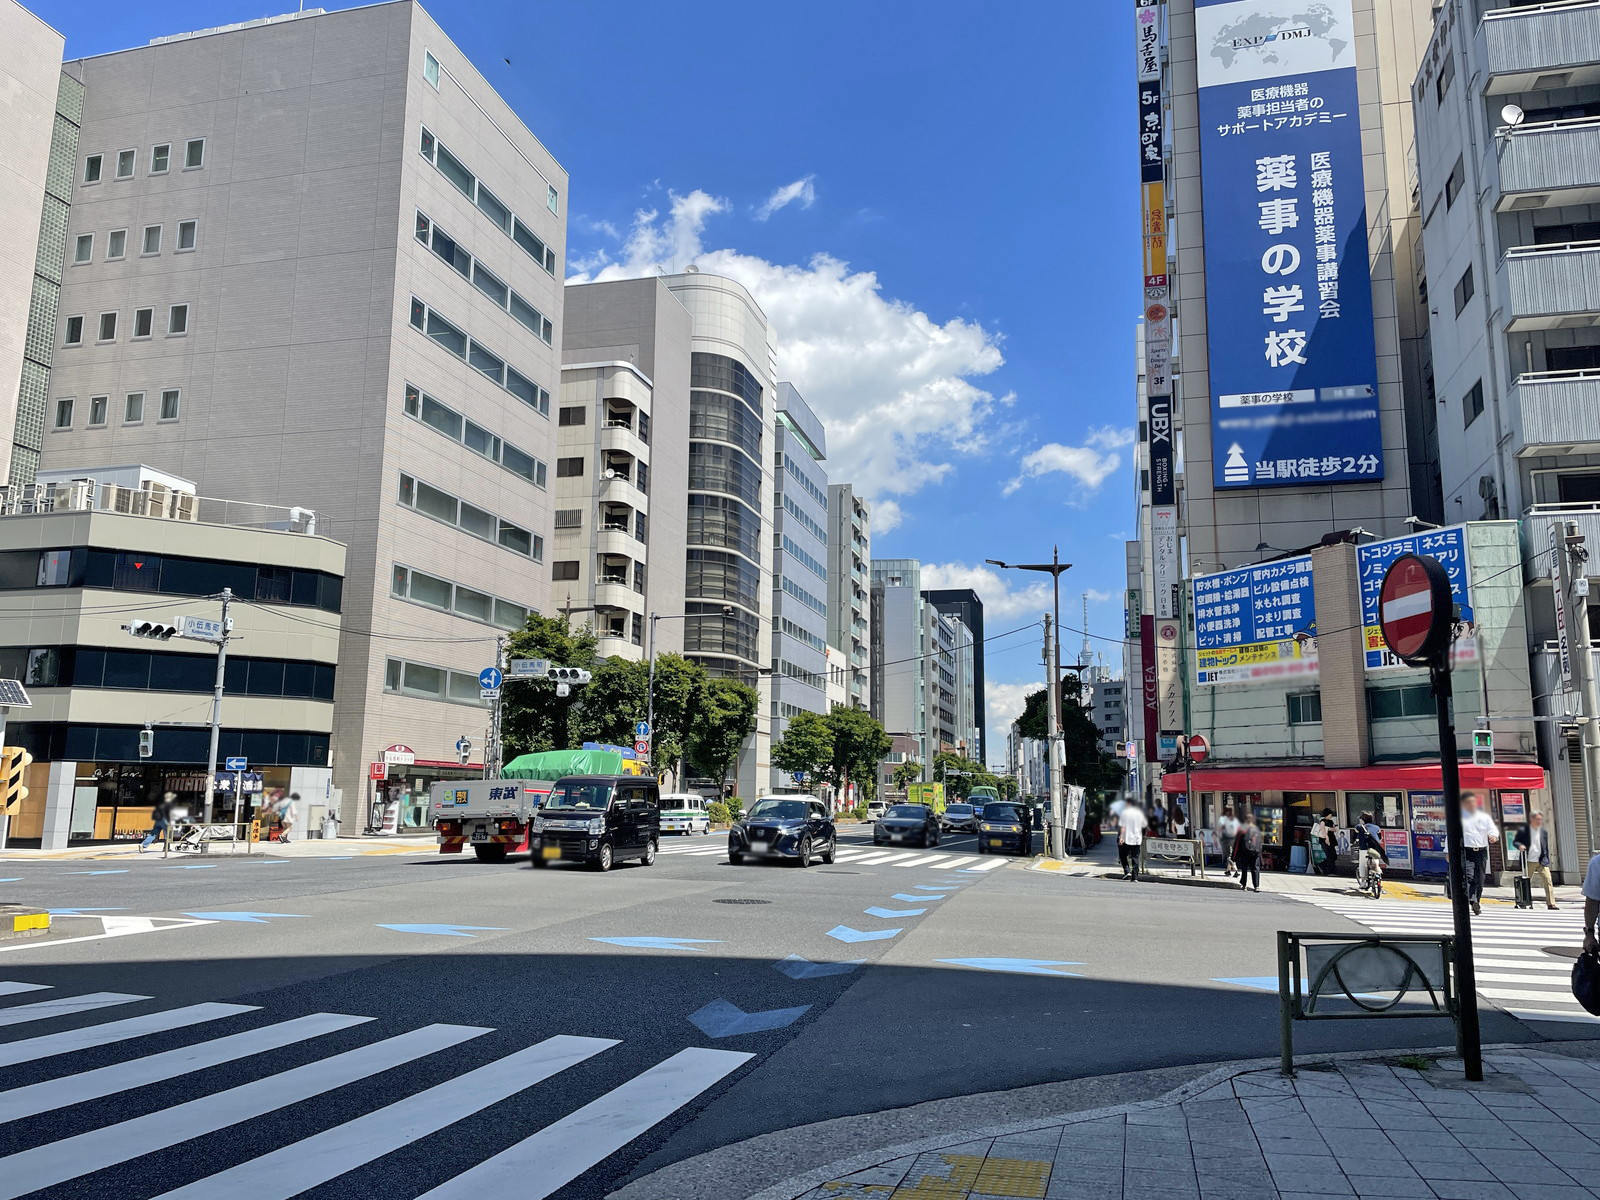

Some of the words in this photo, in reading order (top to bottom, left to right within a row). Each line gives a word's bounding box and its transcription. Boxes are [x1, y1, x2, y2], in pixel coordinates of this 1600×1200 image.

[1233, 35, 1263, 48] EXP
[1281, 28, 1311, 41] DMJ
[1141, 90, 1159, 105] 5F
[1251, 82, 1309, 102] 医療機器
[1237, 96, 1324, 119] 薬事担当者の
[1217, 112, 1347, 137] サポートアカデミー
[1310, 151, 1341, 318] 医療機器薬事講習会
[1256, 154, 1308, 368] 薬事の学校
[1148, 276, 1164, 285] 4F
[1153, 376, 1165, 385] 3F
[1239, 392, 1294, 405] 薬事の学校
[1151, 403, 1170, 443] UBX
[1155, 458, 1163, 492] STRENGTH
[1255, 454, 1380, 479] 当駅徒歩2分
[1422, 533, 1458, 550] ネズミ
[1361, 541, 1414, 562] トコジラミ
[1253, 560, 1313, 581] 管内カメラ調査
[1363, 563, 1388, 577] ノミ、
[1196, 571, 1249, 592] 貯水槽・ポンプ
[1254, 576, 1309, 595] ビル設備点検
[1254, 593, 1301, 610] 水もれ調査
[1197, 603, 1240, 619] 排水管洗浄
[1255, 608, 1302, 623] つまり調査
[188, 619, 220, 632] 小伝馬町
[1256, 624, 1294, 639] 配管工事
[514, 661, 543, 669] 小伝馬町
[1239, 652, 1277, 662] メンテナンス
[1207, 671, 1219, 682] JET
[1145, 665, 1157, 710] ACCEA
[1168, 683, 1176, 726] アカナツメ
[488, 786, 518, 800] 東武
